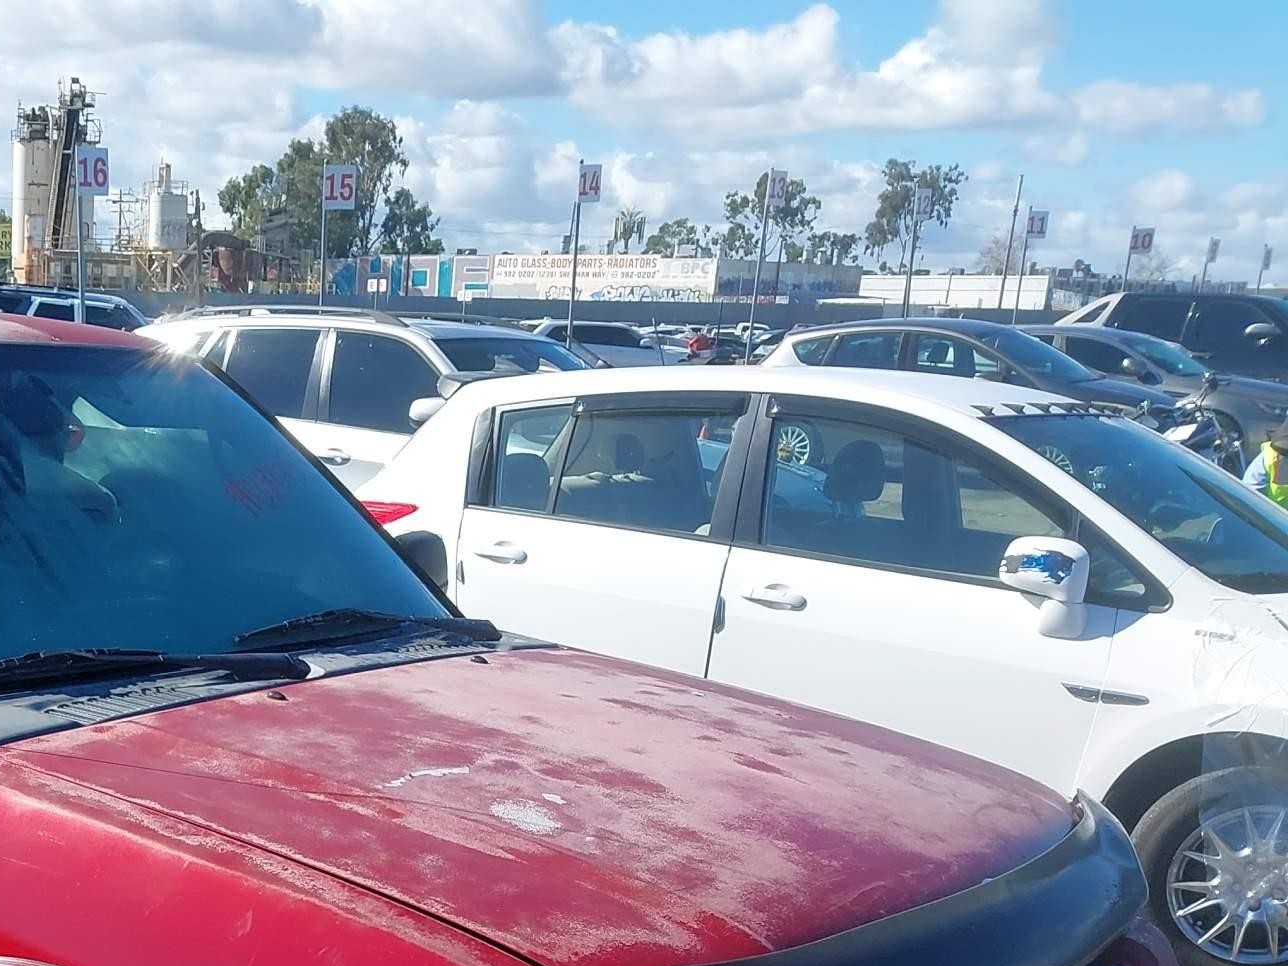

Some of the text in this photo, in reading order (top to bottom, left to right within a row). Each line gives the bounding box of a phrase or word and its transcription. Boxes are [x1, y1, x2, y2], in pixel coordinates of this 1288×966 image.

[78, 156, 108, 188] 16
[325, 173, 354, 201] 15
[579, 171, 600, 196] 14
[769, 176, 786, 199] 13
[1027, 215, 1046, 234] 11
[1130, 232, 1153, 250] 10
[497, 257, 518, 269] AUTO
[680, 261, 711, 274] BPC
